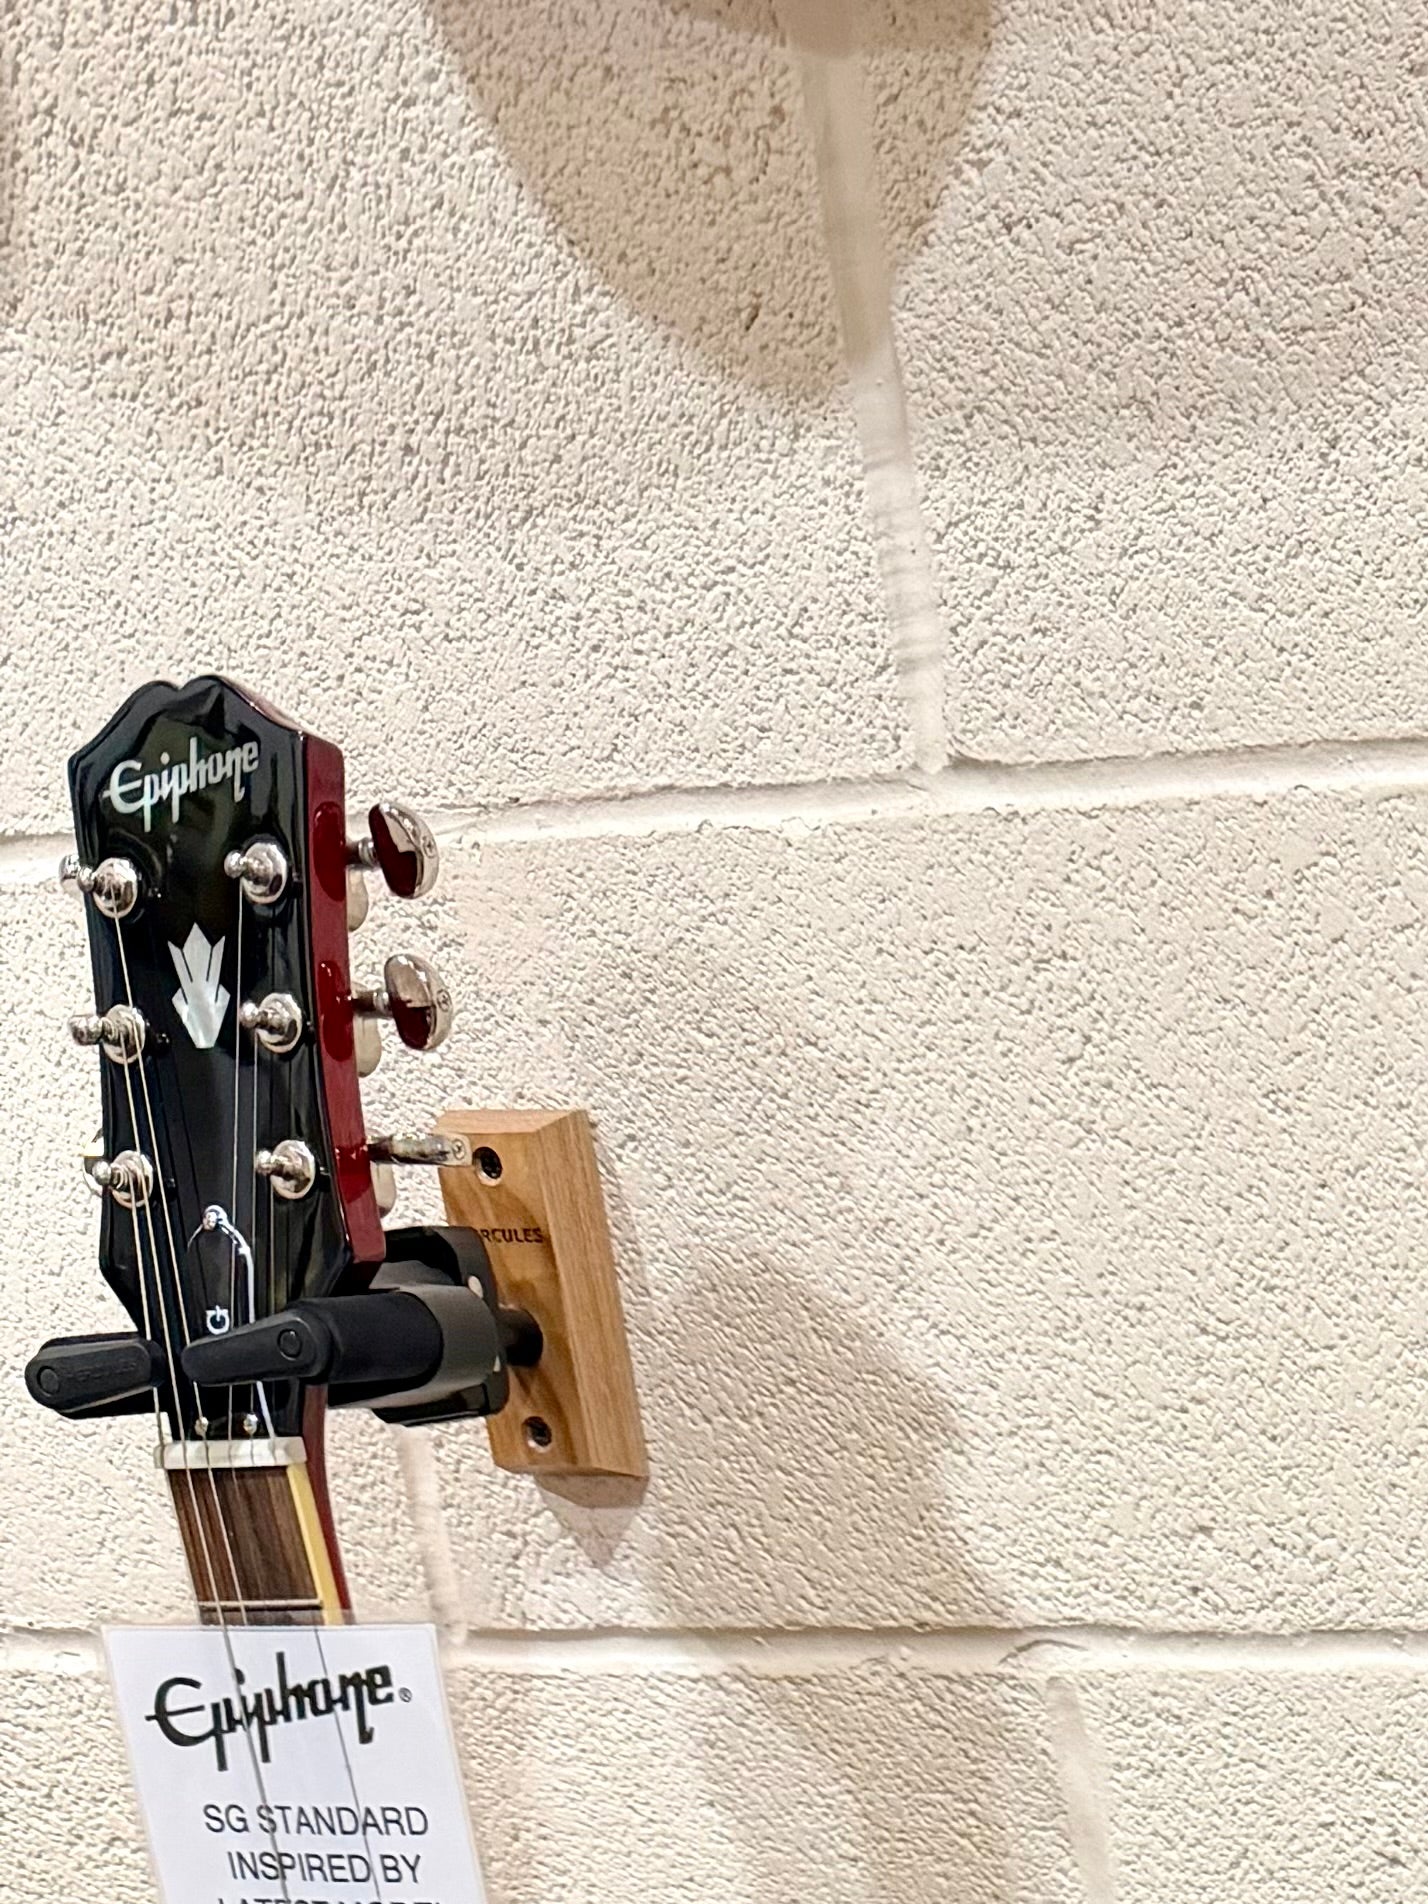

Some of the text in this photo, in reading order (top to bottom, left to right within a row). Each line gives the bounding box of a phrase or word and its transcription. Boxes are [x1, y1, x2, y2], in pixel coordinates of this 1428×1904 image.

[100, 736, 259, 833] Epiphone
[479, 1227, 544, 1244] RCULES
[145, 1651, 394, 1772] Epiphone
[203, 1804, 429, 1836] SG STANDARD
[227, 1851, 421, 1884] INSPIRED BY
